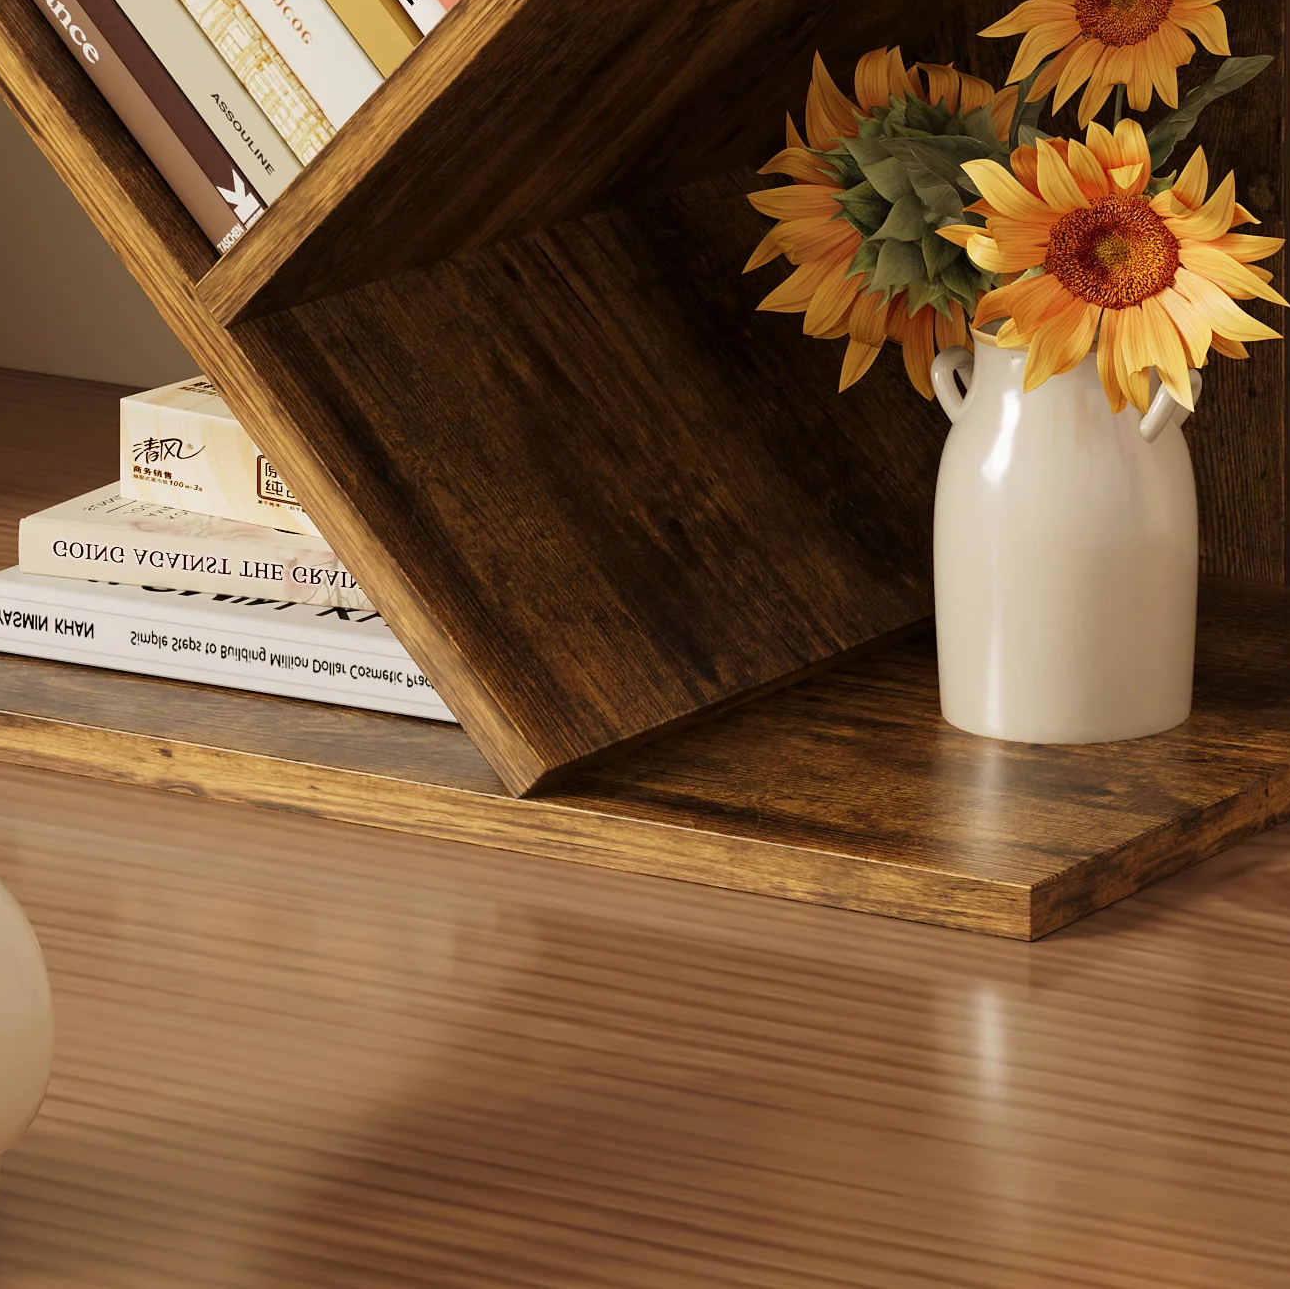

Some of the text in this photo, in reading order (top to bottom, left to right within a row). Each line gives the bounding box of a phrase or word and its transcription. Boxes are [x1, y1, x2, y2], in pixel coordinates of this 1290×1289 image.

[208, 89, 277, 178] ASSOULINE
[214, 224, 250, 258] TASCHEN
[132, 436, 206, 465] 清风
